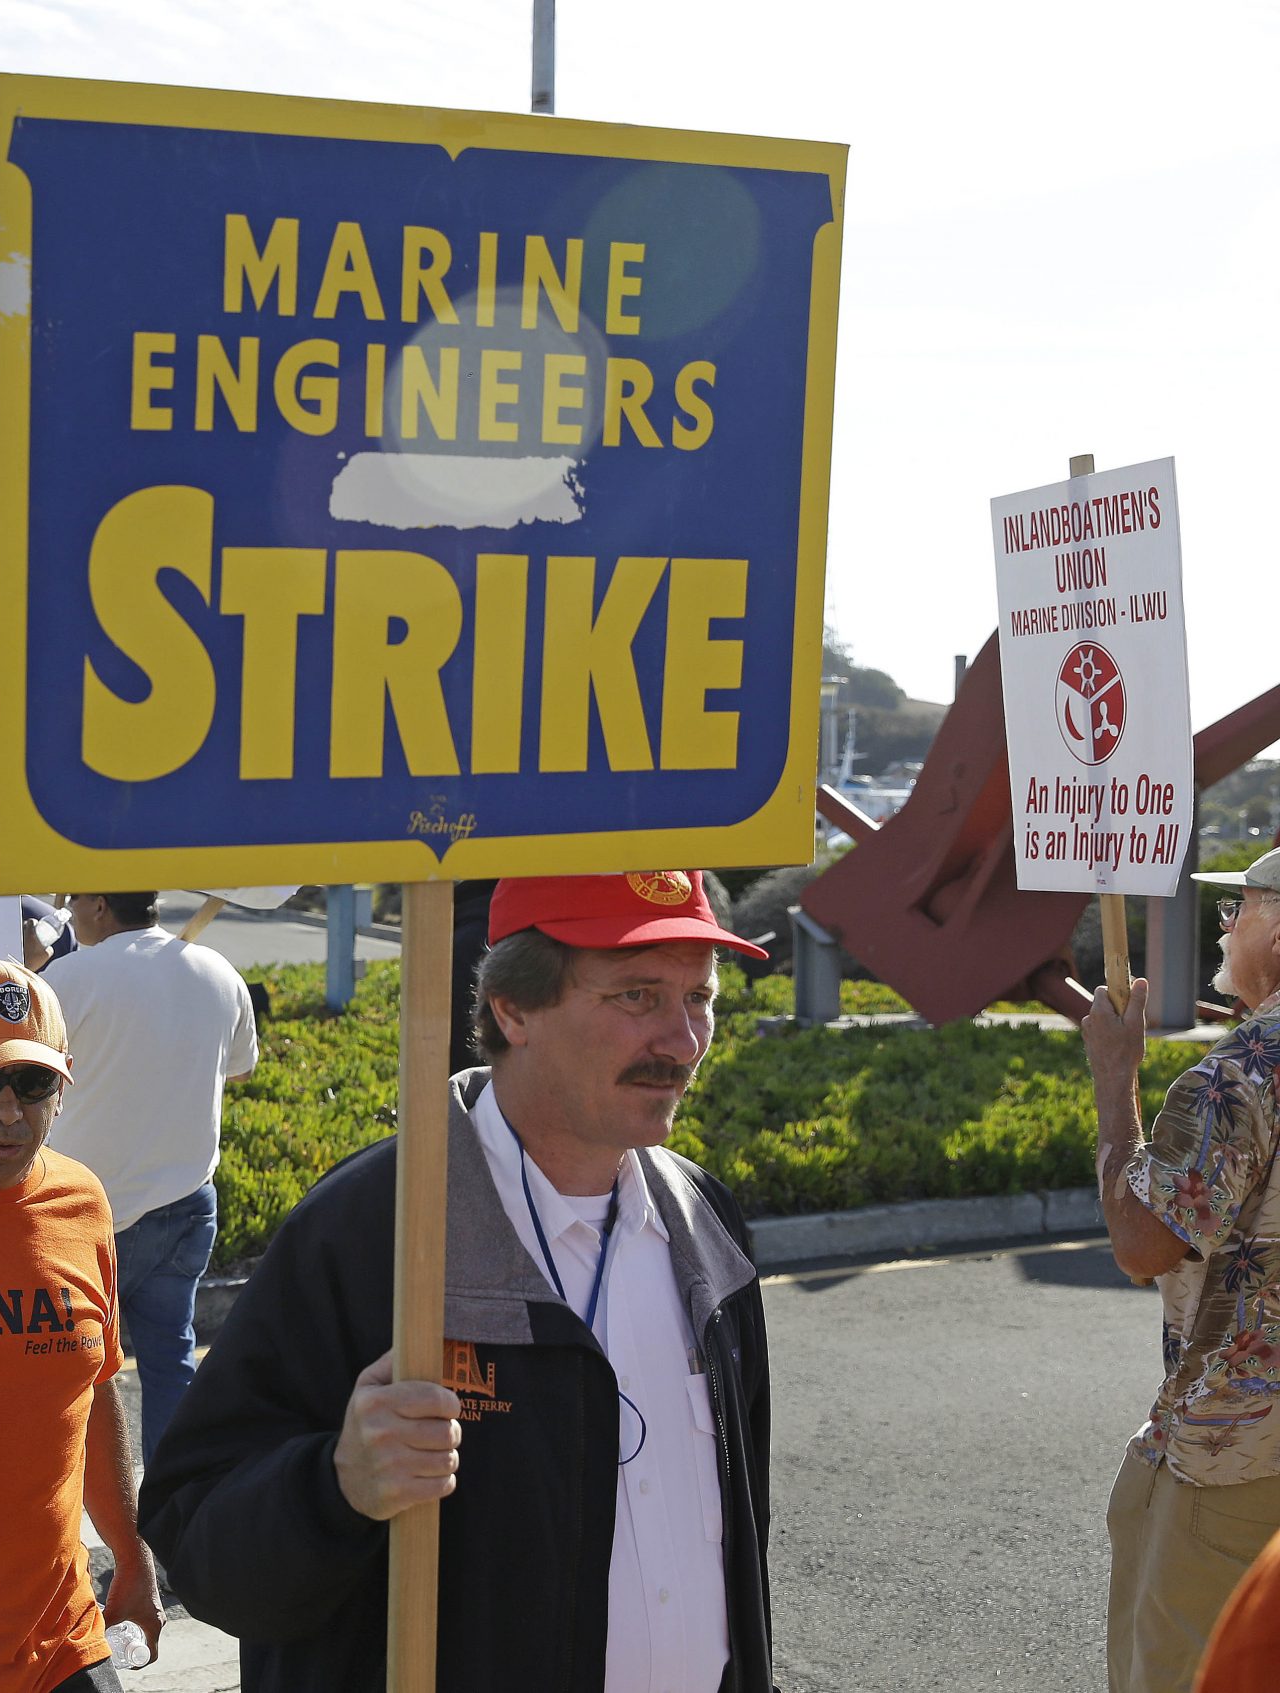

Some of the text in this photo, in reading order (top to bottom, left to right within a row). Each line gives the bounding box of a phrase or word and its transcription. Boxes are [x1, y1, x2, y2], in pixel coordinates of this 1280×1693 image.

[224, 213, 645, 335] MARINE
[130, 332, 717, 451] ENGINEERS
[1003, 487, 1161, 554] INLANDBOATMEN'S
[1055, 547, 1107, 593] UNION
[81, 484, 749, 782] STRIKE
[1011, 605, 1058, 637] MARINE
[1062, 597, 1116, 631] DIVISION
[1130, 590, 1167, 623] ILWU
[1026, 773, 1174, 824] An Injury to One
[1025, 822, 1180, 871] is an Injury to All
[25, 1339, 53, 1355] Feel
[56, 1337, 78, 1352] the
[460, 1399, 513, 1412] ATE FERRY
